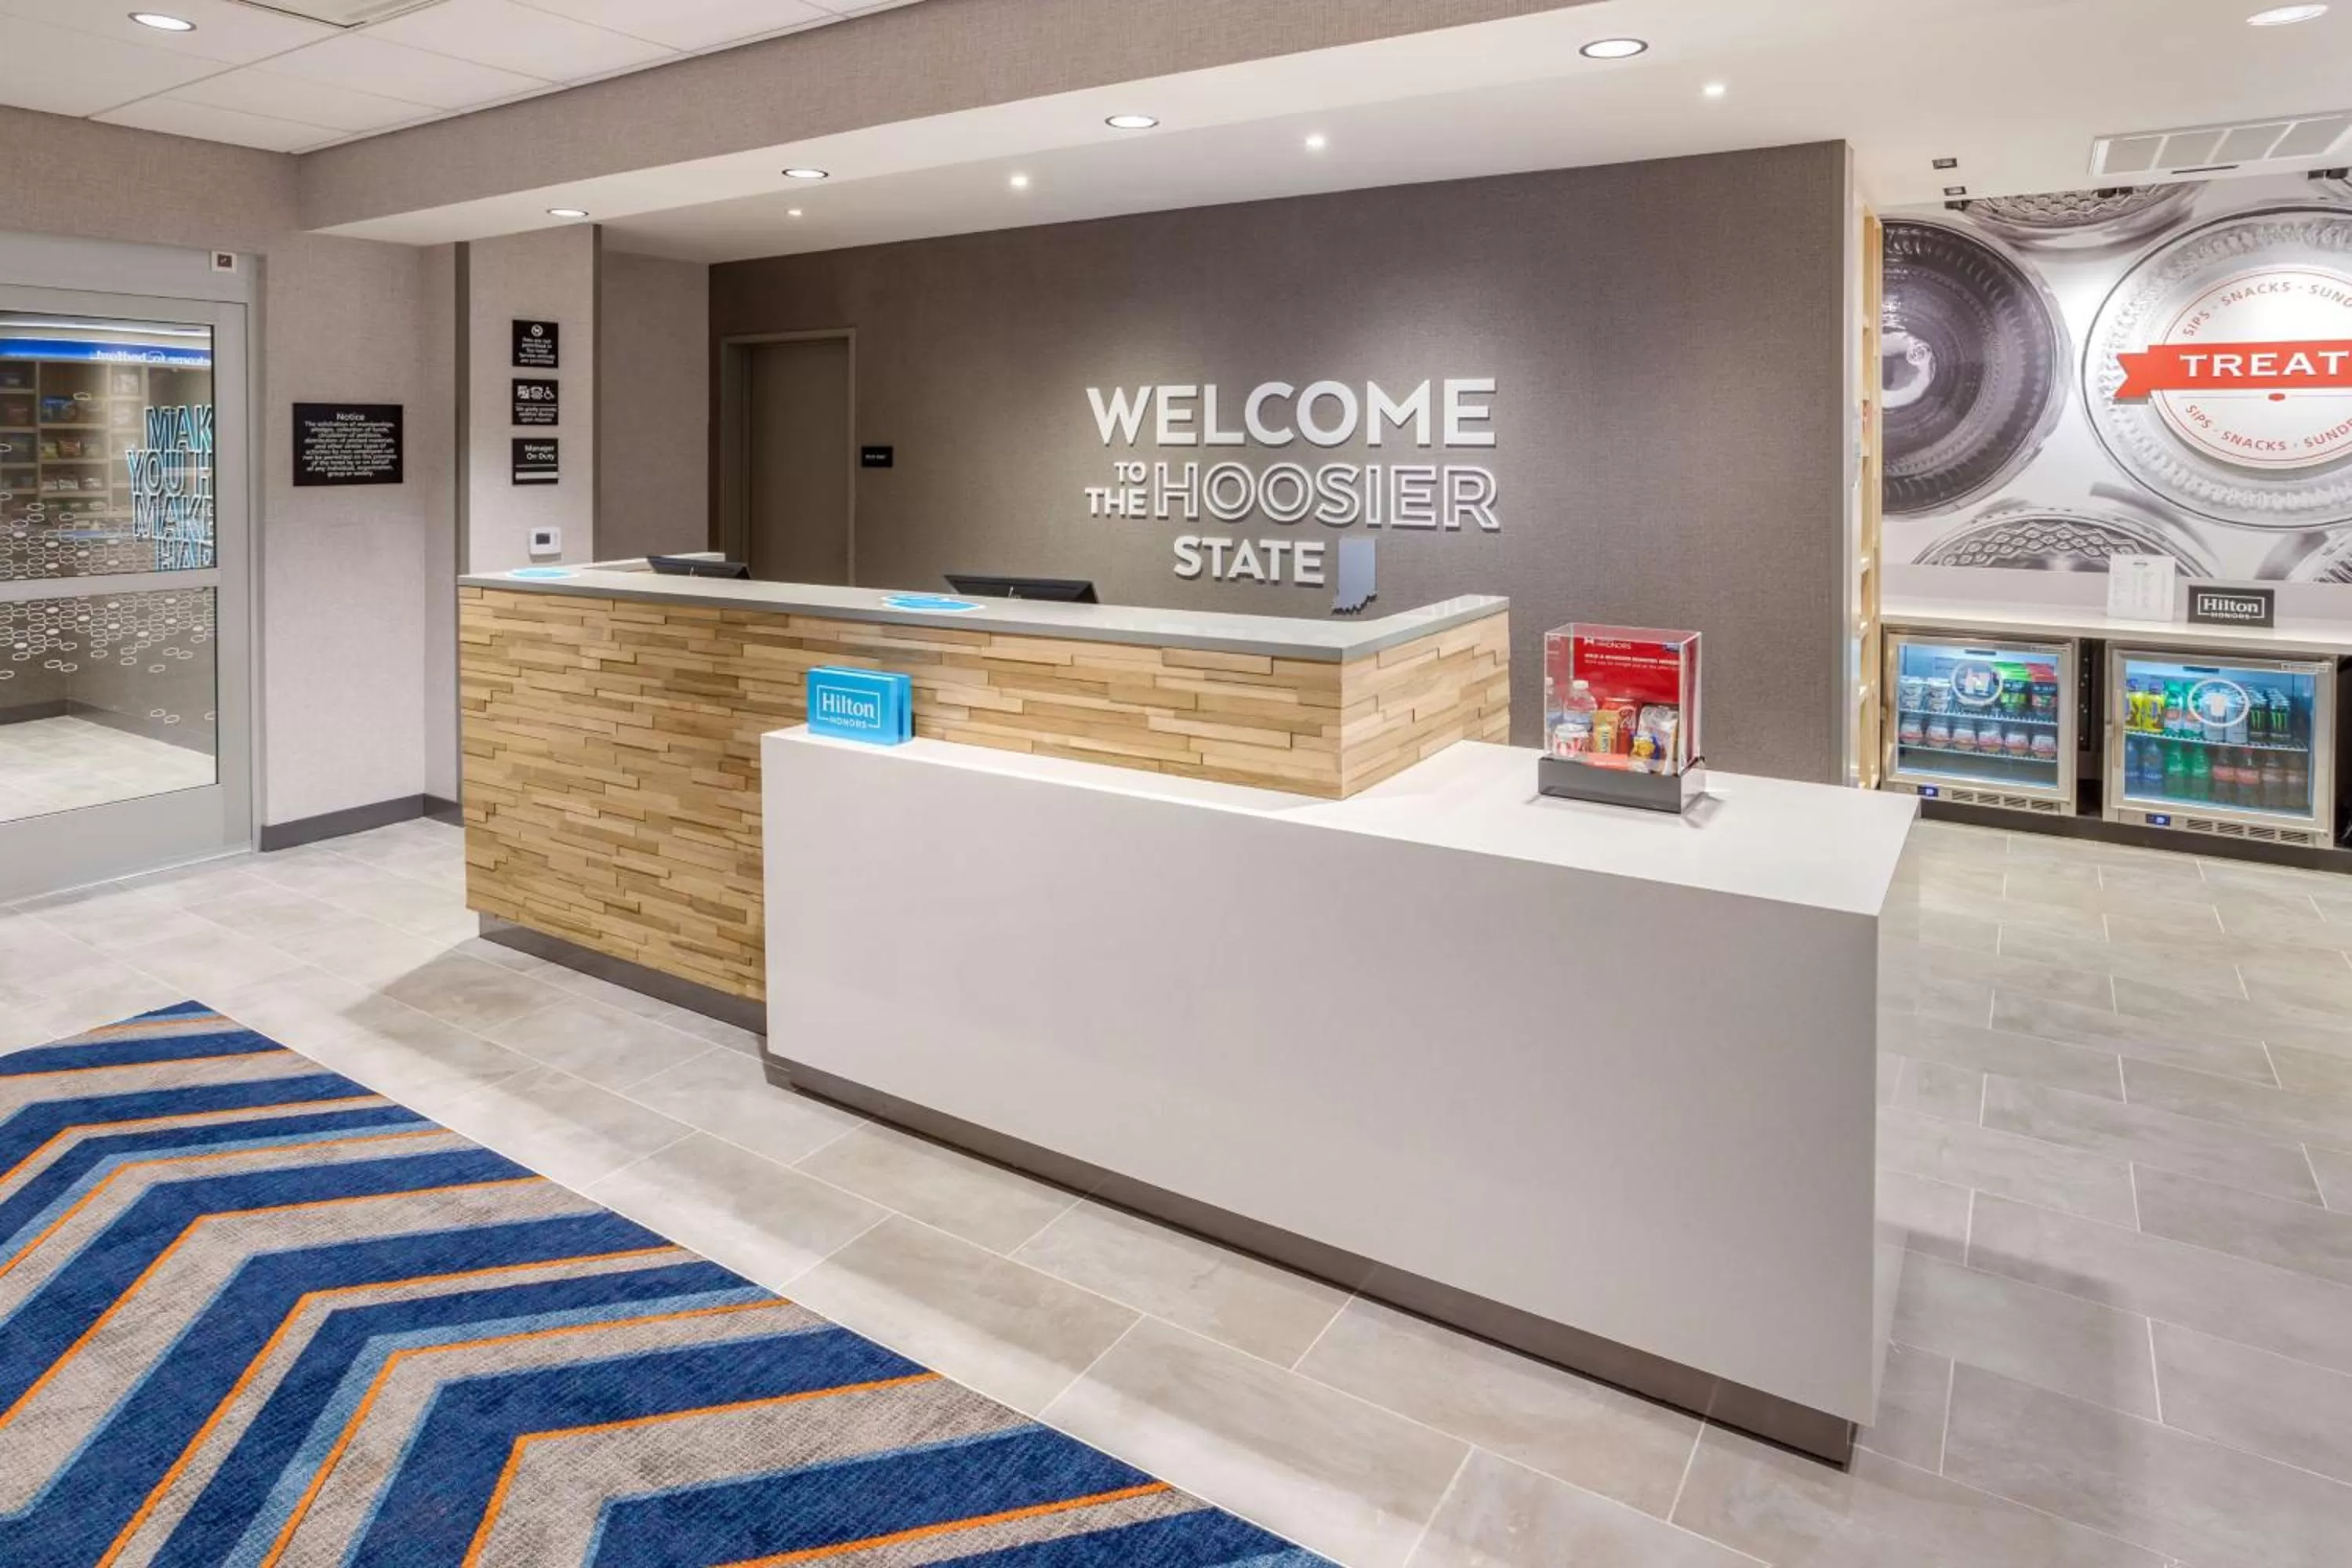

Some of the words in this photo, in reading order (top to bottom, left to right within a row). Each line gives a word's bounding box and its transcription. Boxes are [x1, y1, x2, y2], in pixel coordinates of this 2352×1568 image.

[2183, 310, 2211, 336] SIPS
[2220, 281, 2291, 307] SNACKS
[2180, 350, 2350, 377] TREAT
[336, 412, 365, 421] Notice
[1087, 379, 1497, 448] WELCOME
[2185, 404, 2213, 429] SIPS
[2221, 430, 2287, 451] SNACKS
[125, 450, 184, 496] YOU
[1114, 461, 1146, 484] TO
[1085, 486, 1147, 519] THE
[1153, 461, 1500, 531] HOOSIER
[132, 495, 213, 543] MAKE
[1173, 535, 1325, 586] STATE
[2202, 597, 2259, 613] Hilton
[2209, 612, 2251, 620] HONORS
[822, 692, 876, 719] Hilton
[827, 717, 867, 729] HONORS
